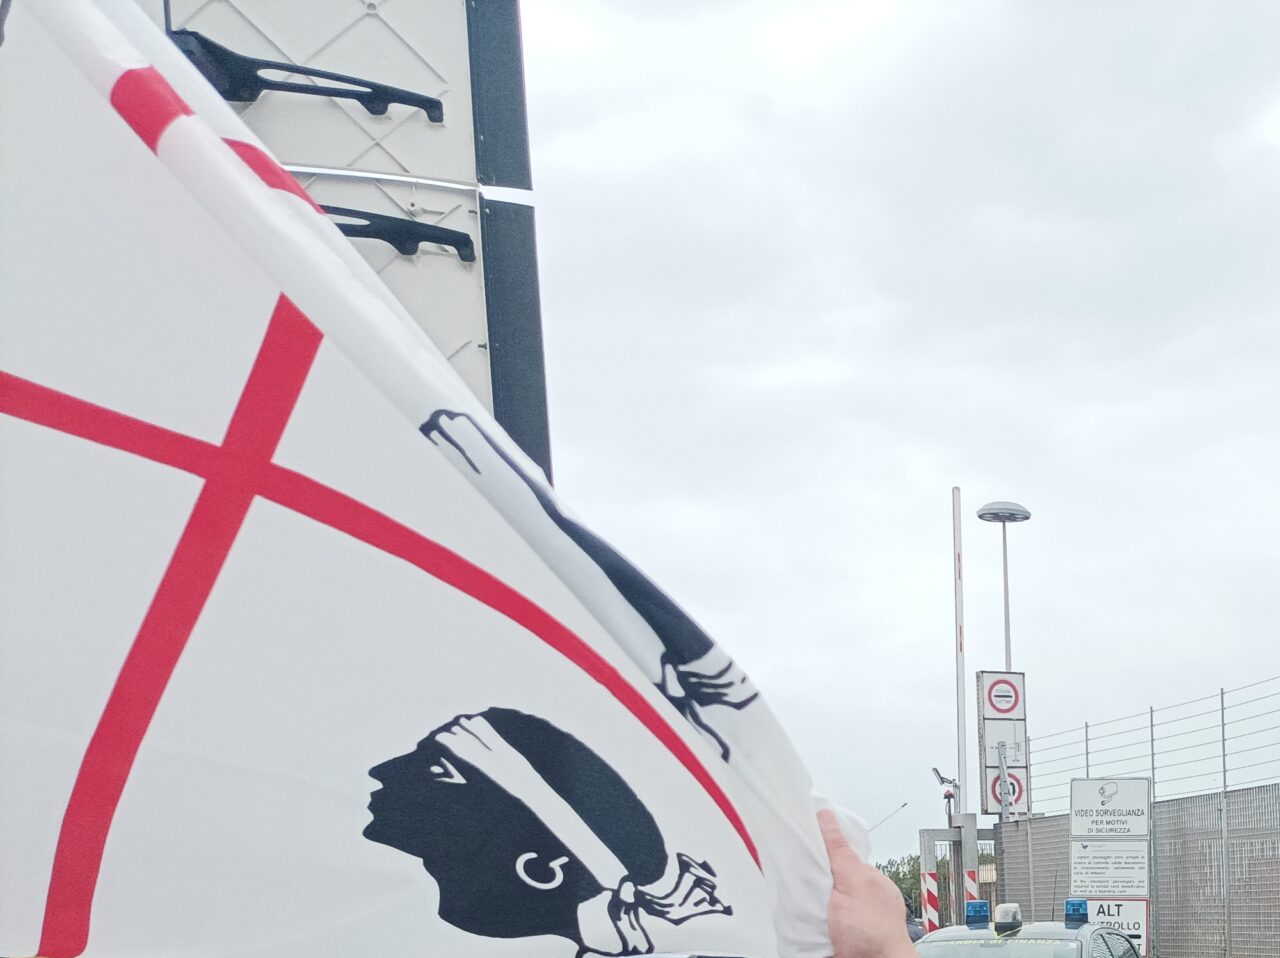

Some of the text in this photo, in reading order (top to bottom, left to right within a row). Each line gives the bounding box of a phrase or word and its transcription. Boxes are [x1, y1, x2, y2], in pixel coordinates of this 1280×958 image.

[1074, 808, 1145, 817] VIDEO SORVEGLIANZA
[1096, 903, 1123, 917] ALT
